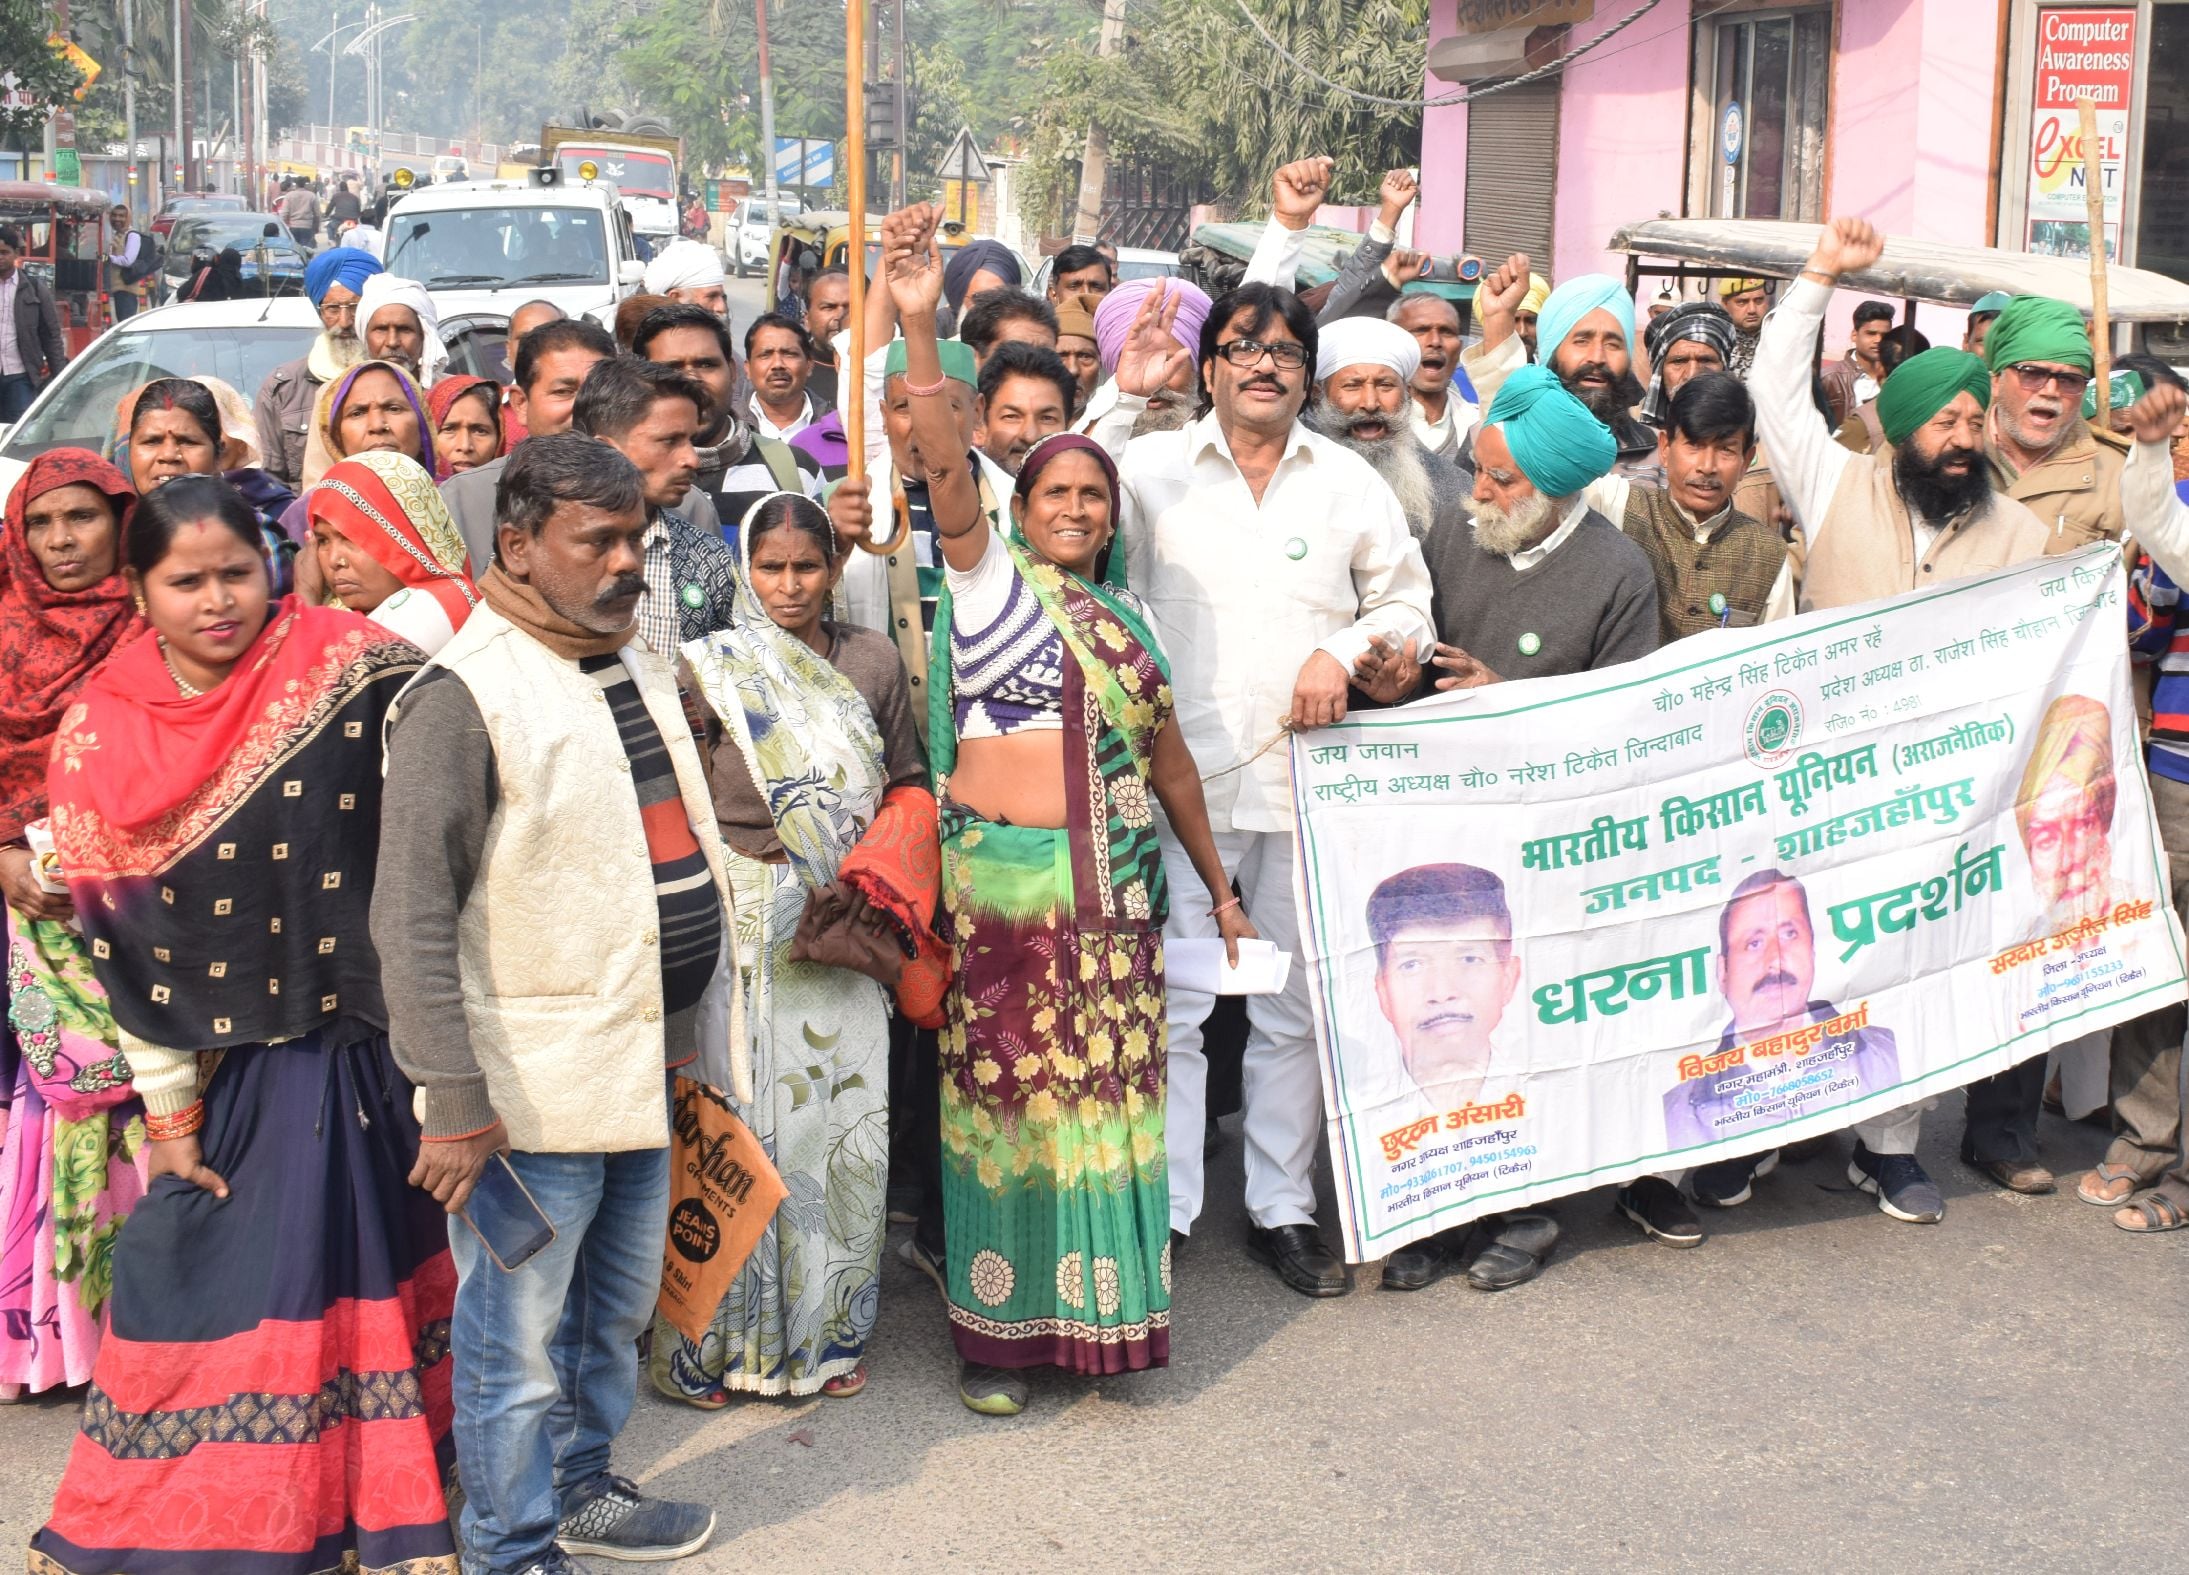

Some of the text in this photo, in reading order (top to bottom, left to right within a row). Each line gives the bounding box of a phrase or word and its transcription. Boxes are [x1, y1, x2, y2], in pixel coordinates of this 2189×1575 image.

[2045, 15, 2129, 46] Computer
[2040, 44, 2130, 71] Awareness
[2047, 76, 2119, 103] Program
[2070, 167, 2118, 188] NT
[2040, 576, 2067, 598] जय
[1652, 624, 1883, 713] चौ० महेन्द्र सिंह टिकैत अमर रहें
[1819, 675, 1856, 702] प्रदेश
[1862, 660, 1903, 687] अध्यक्ष
[1908, 653, 1930, 673] ठा.
[1934, 638, 1976, 664] राजेश
[1979, 625, 2009, 652] सिंह
[2011, 617, 2060, 642] चौहान
[1308, 743, 1419, 765] जय जवान
[1313, 724, 1704, 803] राष्ट्रीय अध्यक्ष चौ० नरेश टिकैत जिन्दाबाद
[1521, 712, 2015, 871] भारतीय किसान यूनियन (अराजनैतिक)
[1580, 855, 1721, 914] जनपद
[1826, 841, 2006, 963] प्रदर्शन
[1988, 899, 2152, 975] सरदार अजीत सिंह
[1531, 946, 1711, 1025] धरना
[2042, 961, 2067, 977] जिला
[2020, 1003, 2049, 1019] भारतीय
[2050, 992, 2080, 1007] किसान
[2080, 980, 2112, 998] यूनियन
[1679, 1001, 1869, 1081] विजय बहादुर वर्मा
[1714, 1076, 1859, 1127] भारतीय किसान यूनियन (टिकैत)
[1716, 1078, 1743, 1093] नगर
[1446, 1093, 1525, 1130] अंसारी
[1391, 1157, 1416, 1173] नगर
[1419, 1146, 1449, 1165] अध्यक्ष
[687, 1162, 736, 1219] GAMENTS
[1387, 1158, 1531, 1213] भारतीय किसान यूनियन (टिकैत)
